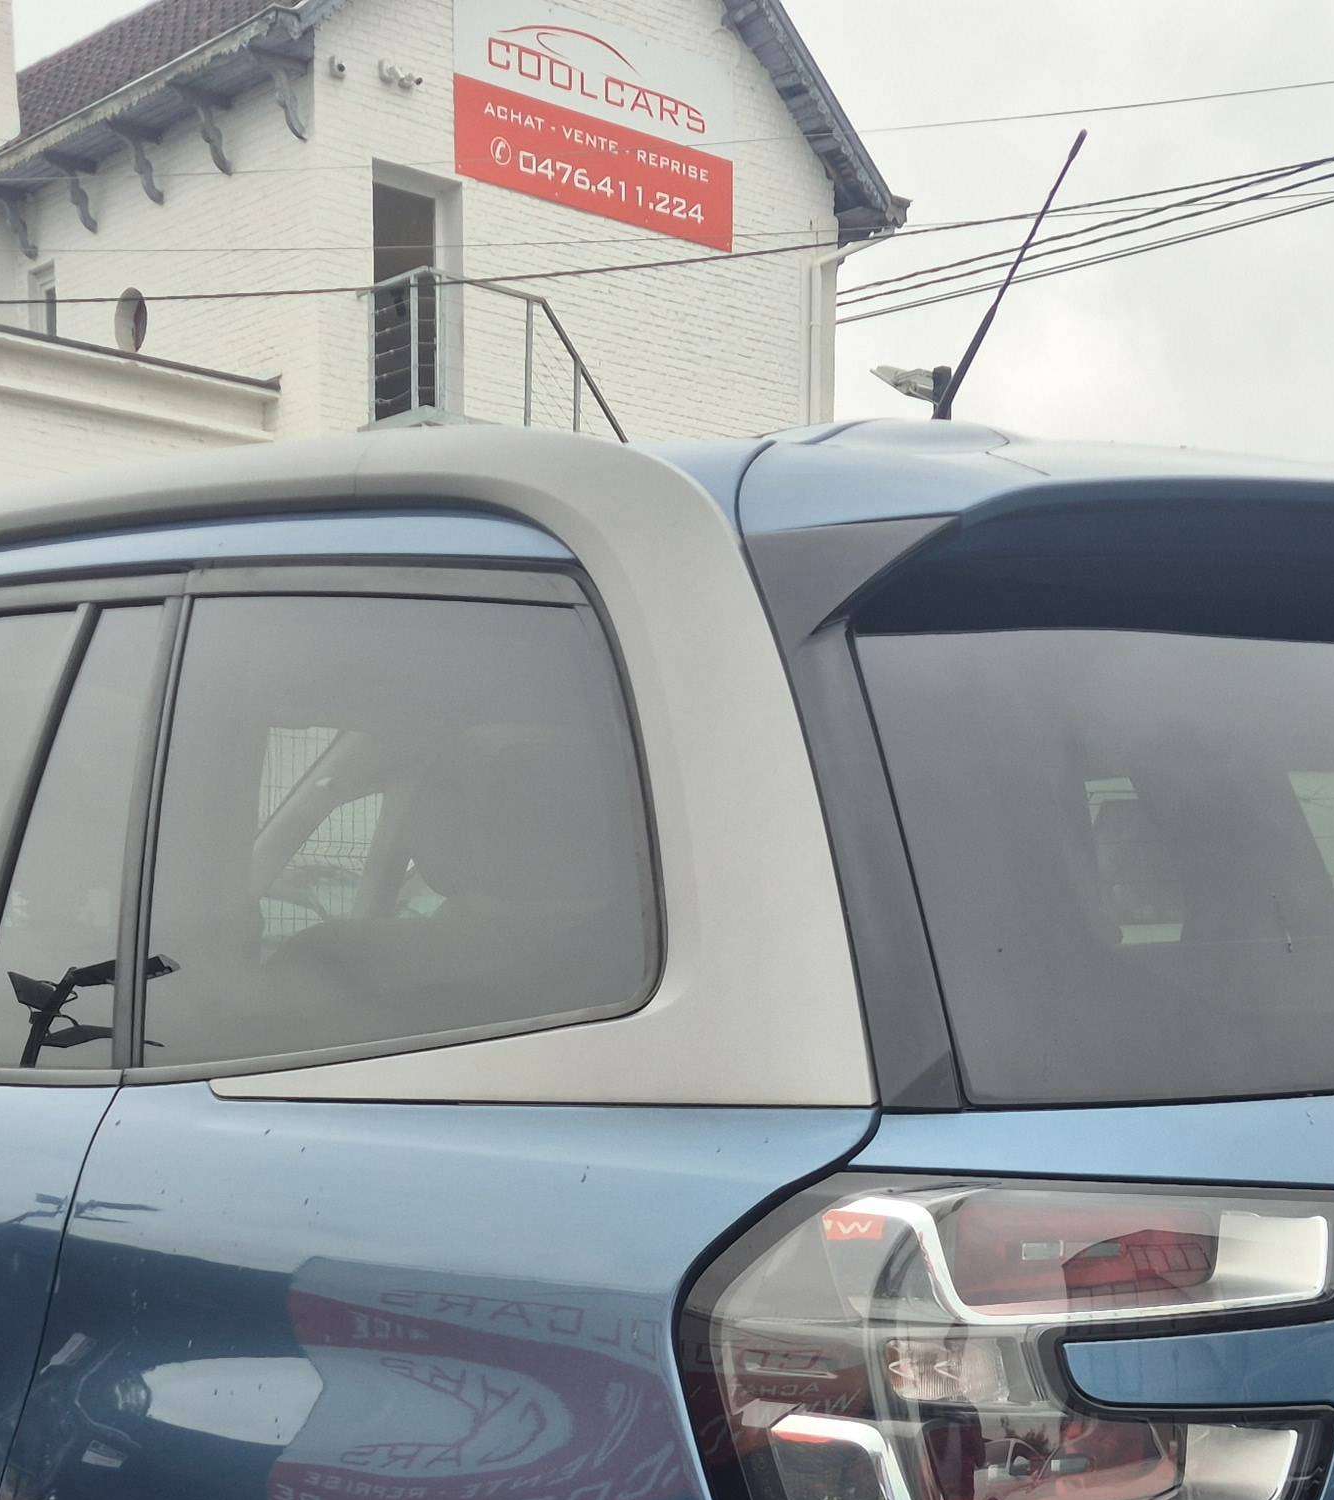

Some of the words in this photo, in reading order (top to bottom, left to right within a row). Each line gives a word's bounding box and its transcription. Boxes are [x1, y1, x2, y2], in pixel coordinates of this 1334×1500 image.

[488, 36, 706, 135] COOLCARS
[484, 101, 545, 132] ACHAT
[562, 125, 618, 154] VENTE
[637, 149, 710, 183] REPRISE
[519, 150, 704, 225] 0476.411.224
